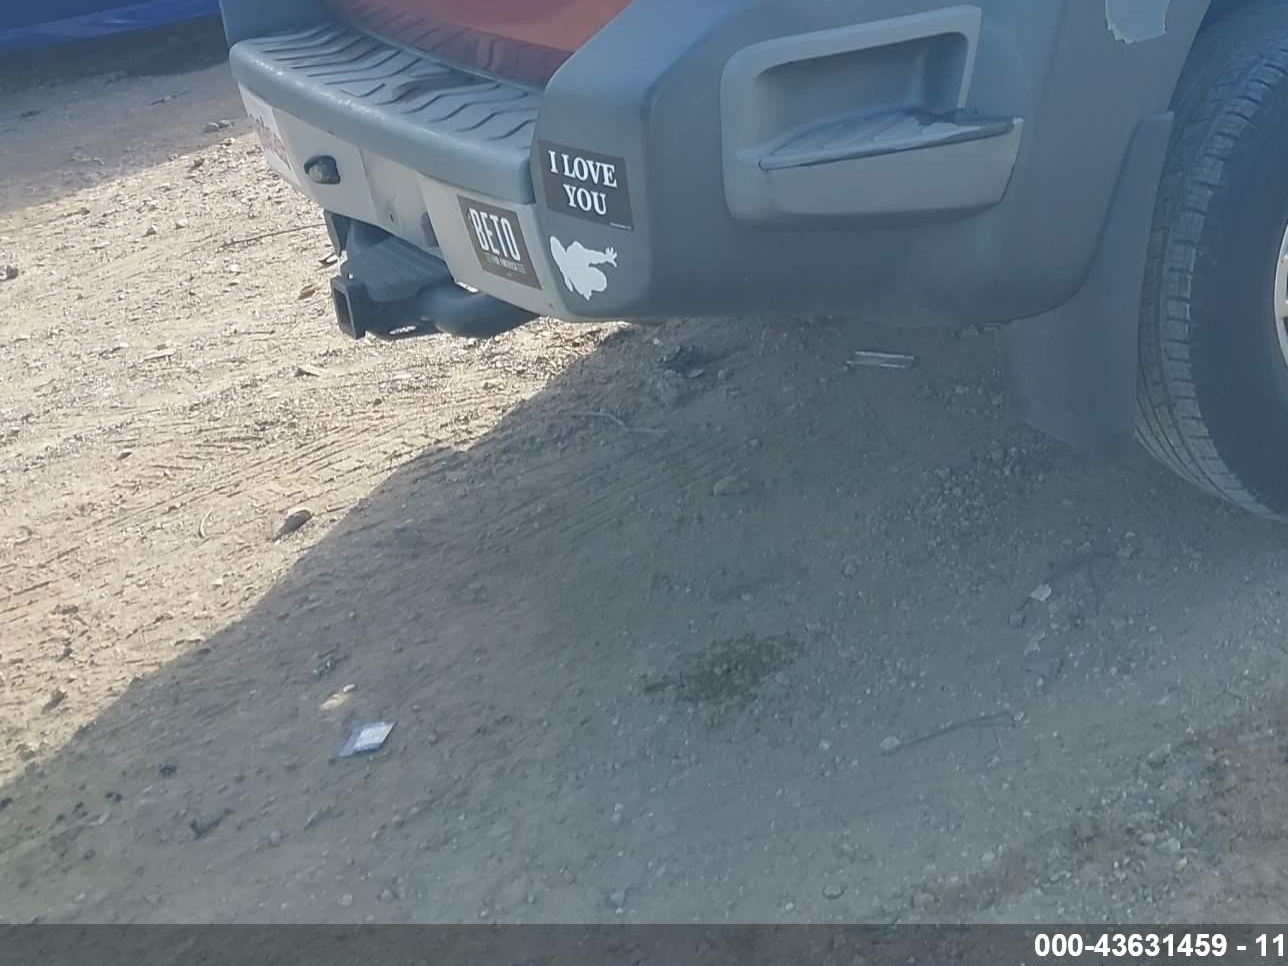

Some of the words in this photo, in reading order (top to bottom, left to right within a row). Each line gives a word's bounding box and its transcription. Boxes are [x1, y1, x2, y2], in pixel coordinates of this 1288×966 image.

[548, 150, 558, 173] I
[561, 153, 617, 188] LOVE
[562, 183, 607, 215] YOU
[468, 207, 521, 261] BETO
